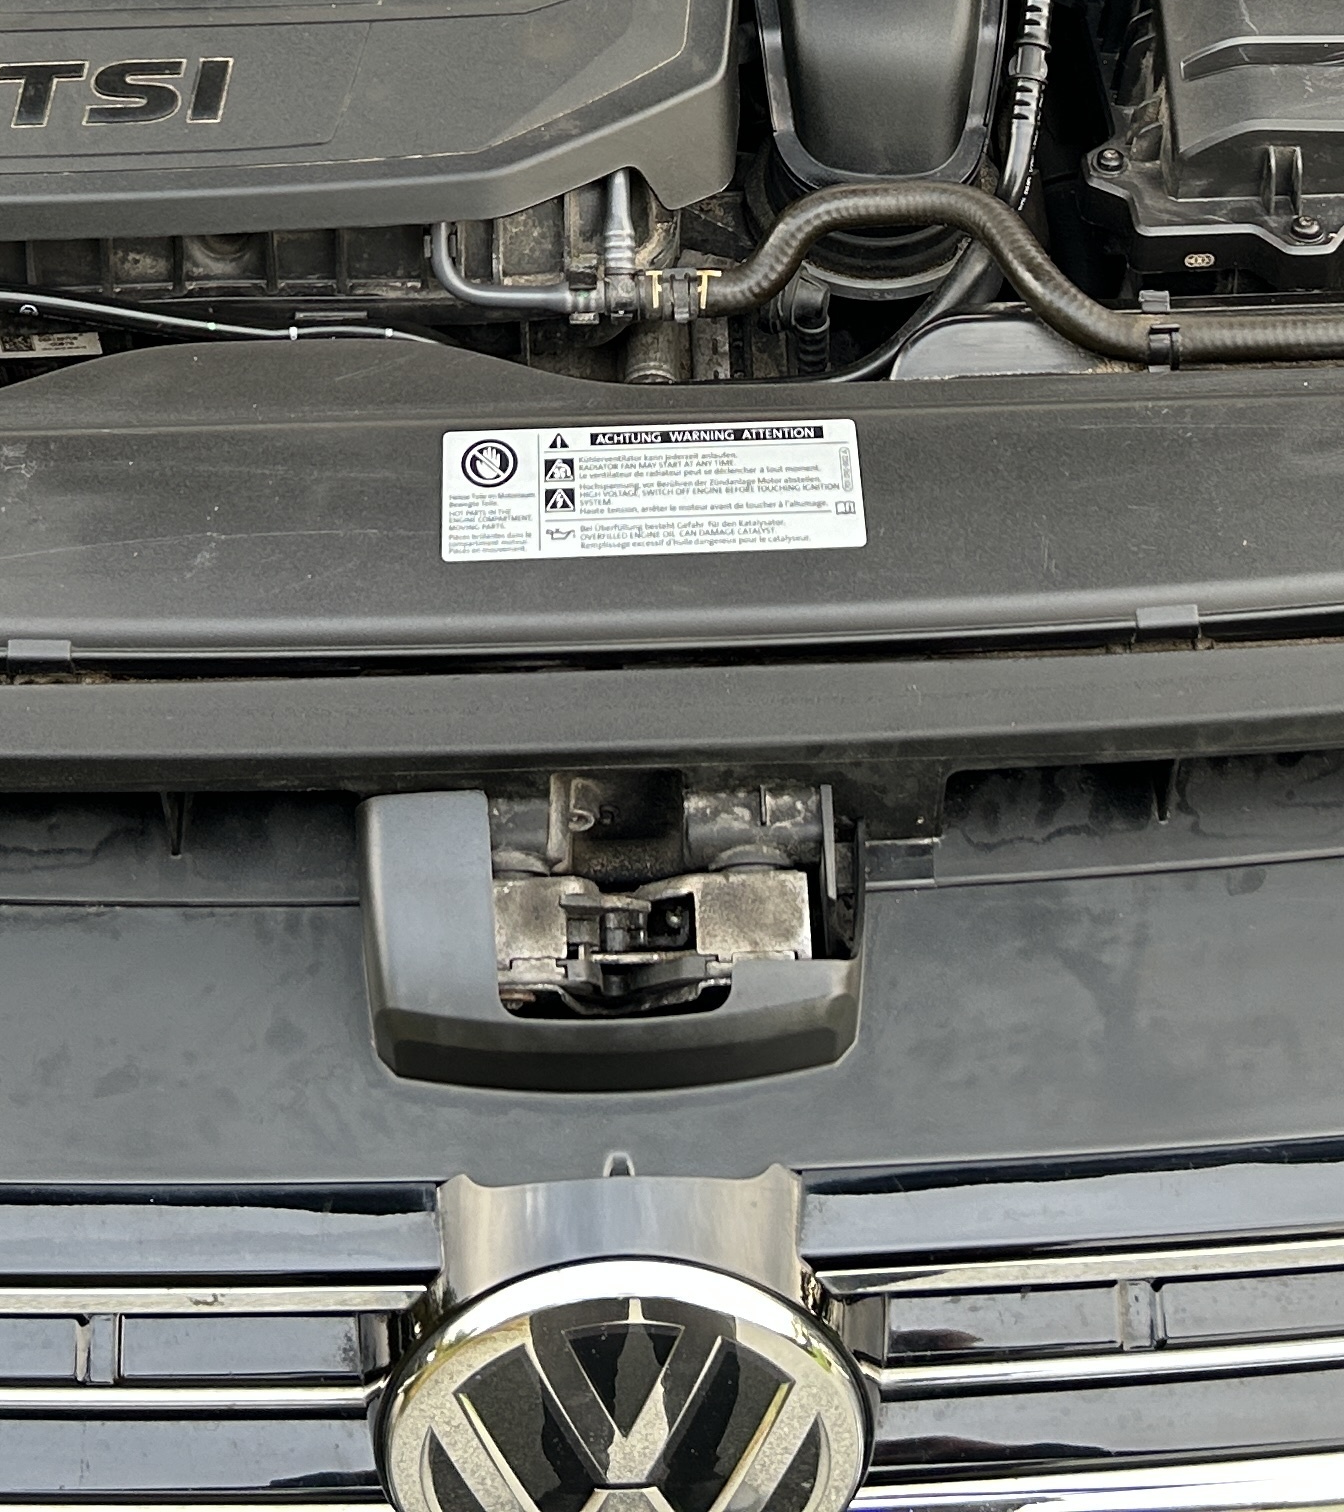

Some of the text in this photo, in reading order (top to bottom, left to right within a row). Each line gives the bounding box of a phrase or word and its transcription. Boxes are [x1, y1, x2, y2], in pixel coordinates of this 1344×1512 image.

[595, 427, 815, 445] ACHTUNG WARNING ATTENTION
